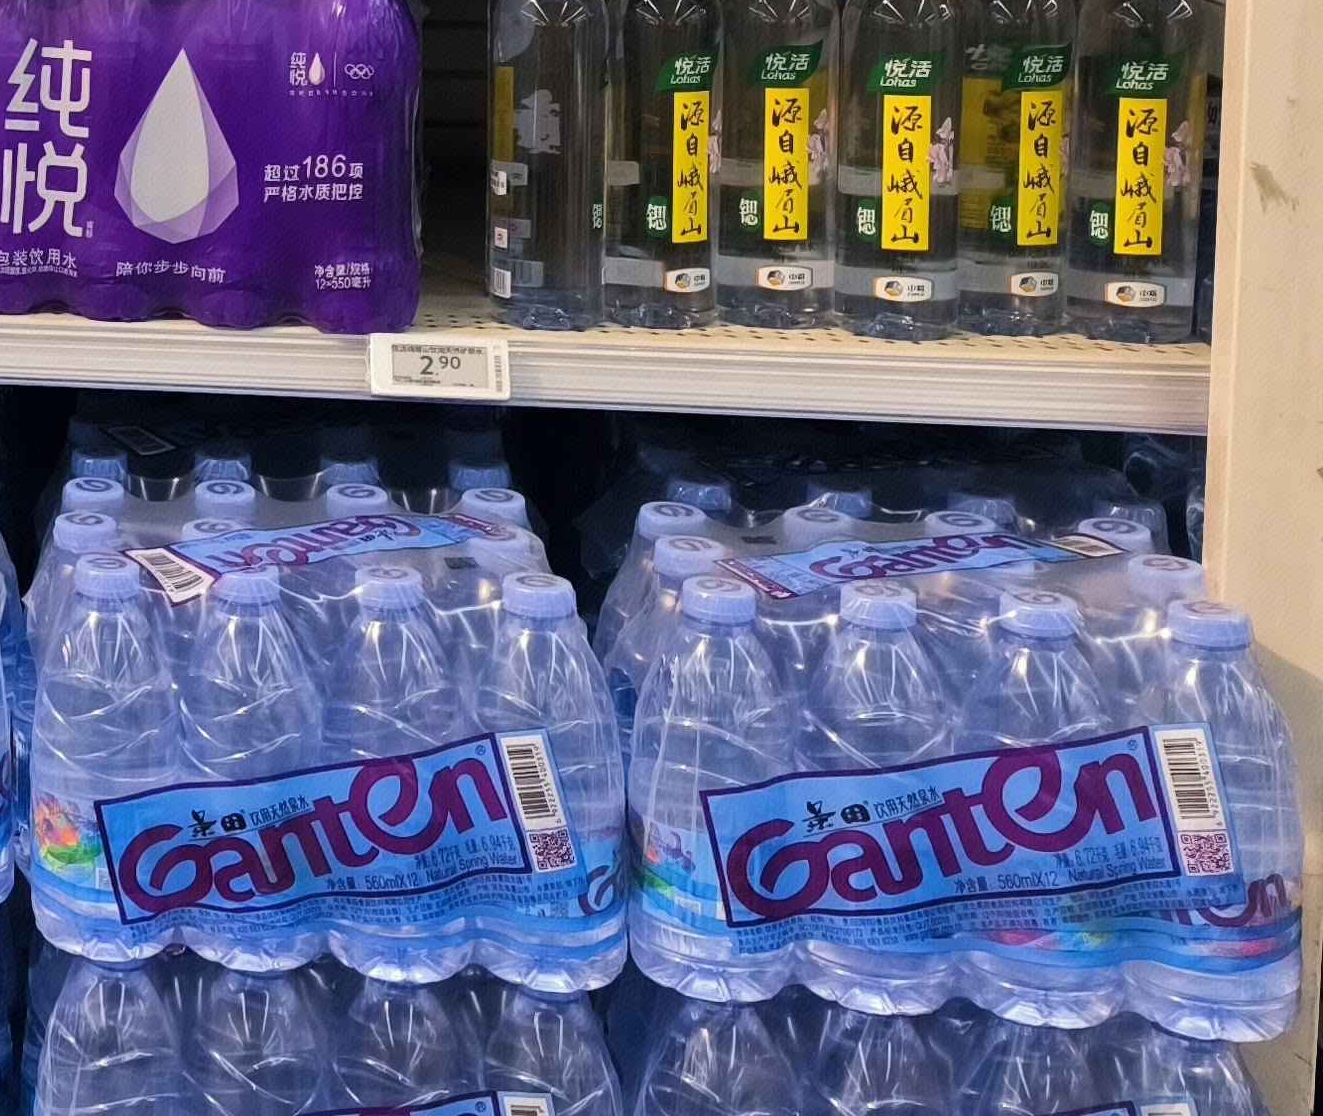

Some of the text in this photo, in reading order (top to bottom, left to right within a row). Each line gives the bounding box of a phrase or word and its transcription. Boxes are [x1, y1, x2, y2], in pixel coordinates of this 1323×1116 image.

[761, 68, 797, 81] Lohas
[766, 52, 810, 74] 悦活
[885, 57, 932, 78] 悦活
[1022, 53, 1063, 75] 悦活
[1122, 61, 1169, 83] 悦活
[880, 74, 917, 88] Lohas
[1116, 78, 1154, 91] Lohas
[0, 37, 94, 236] 纯悦
[262, 154, 364, 182] 超过186项
[769, 97, 804, 236] 源自峨眉山
[887, 105, 924, 245] 源自峨眉山
[1023, 101, 1058, 240] 源自峨眉山
[1119, 107, 1159, 250] 源自峨眉山
[262, 182, 364, 203] 严格水质把控
[115, 260, 227, 283] 陪你步步向前
[250, 794, 311, 826] 饮用天然泉水
[874, 786, 942, 818] 饮用天然泉水
[117, 756, 508, 914] Ganten
[726, 746, 1159, 920] Ganten
[1067, 858, 1166, 884] Natural Spring Water
